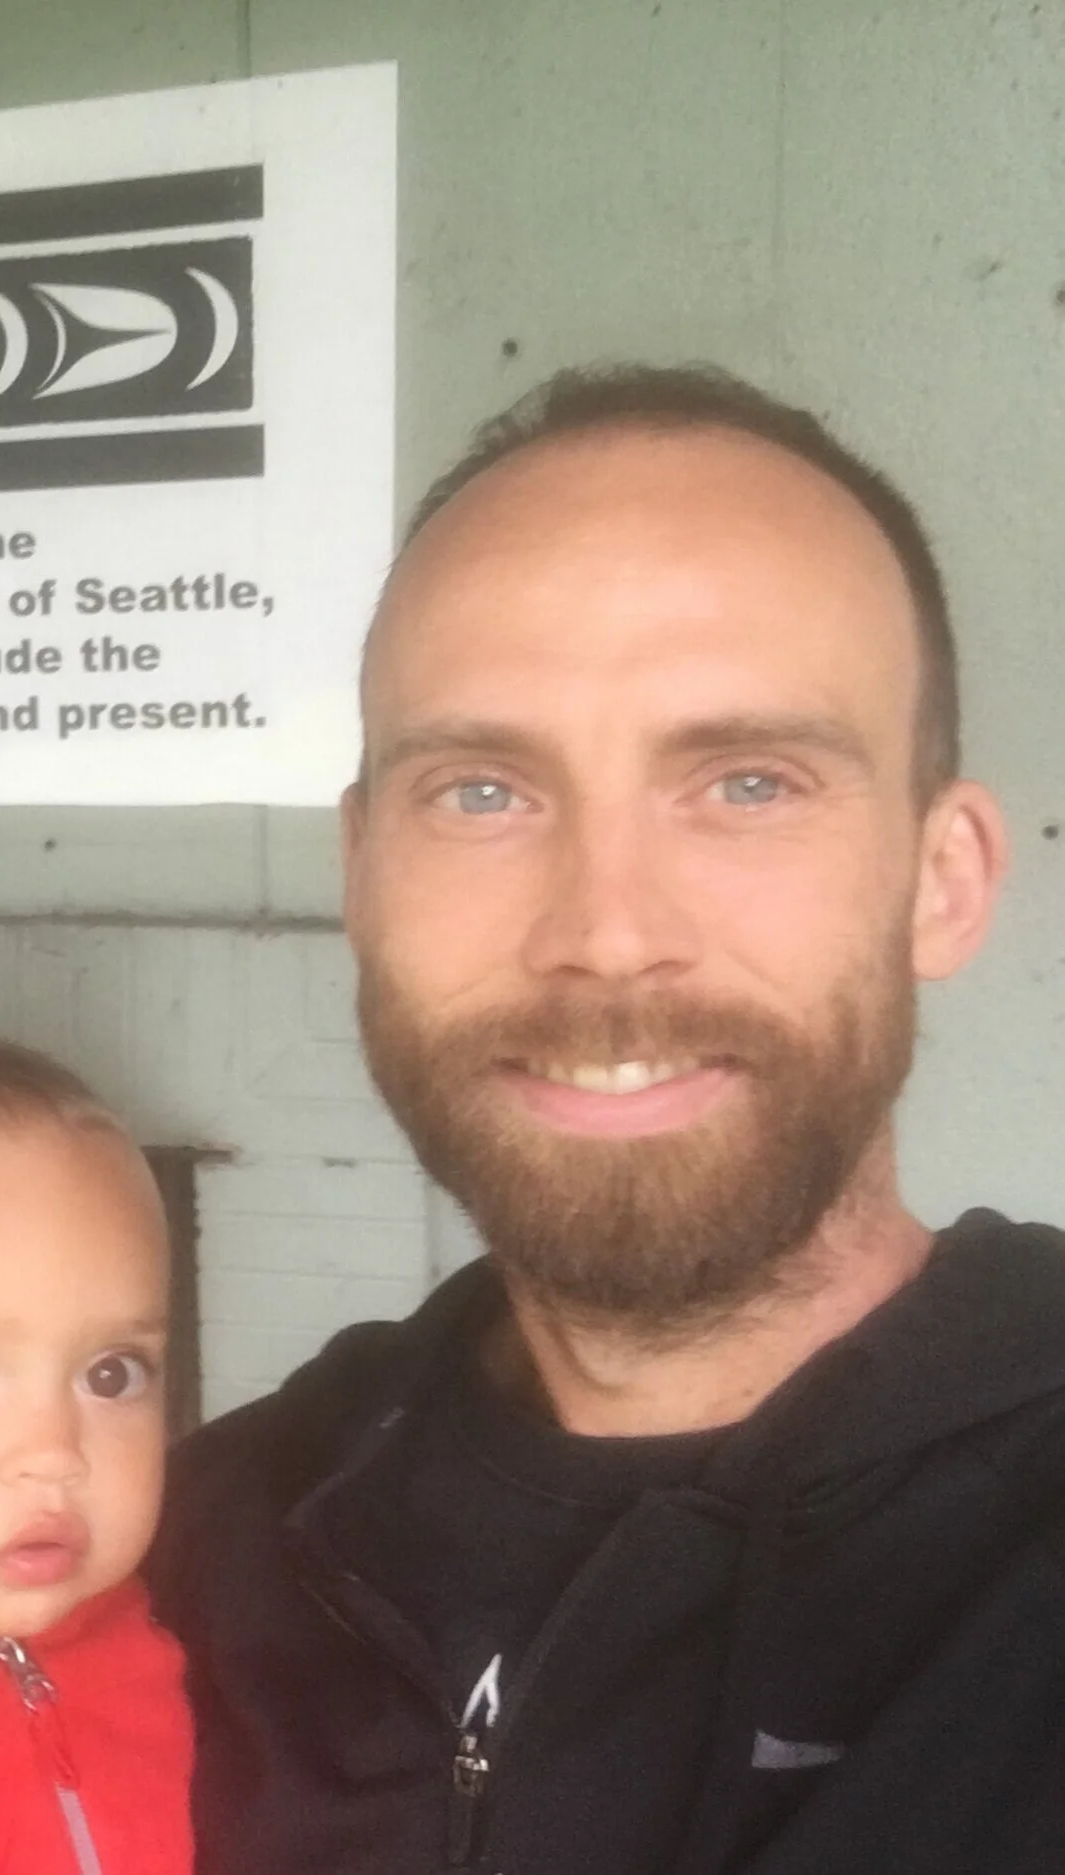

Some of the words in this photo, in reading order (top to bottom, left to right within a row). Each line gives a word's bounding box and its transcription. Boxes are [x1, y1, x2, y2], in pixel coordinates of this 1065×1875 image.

[9, 580, 56, 616] of
[76, 573, 273, 616] Seattle,
[81, 636, 160, 672] the
[59, 694, 264, 739] present.
